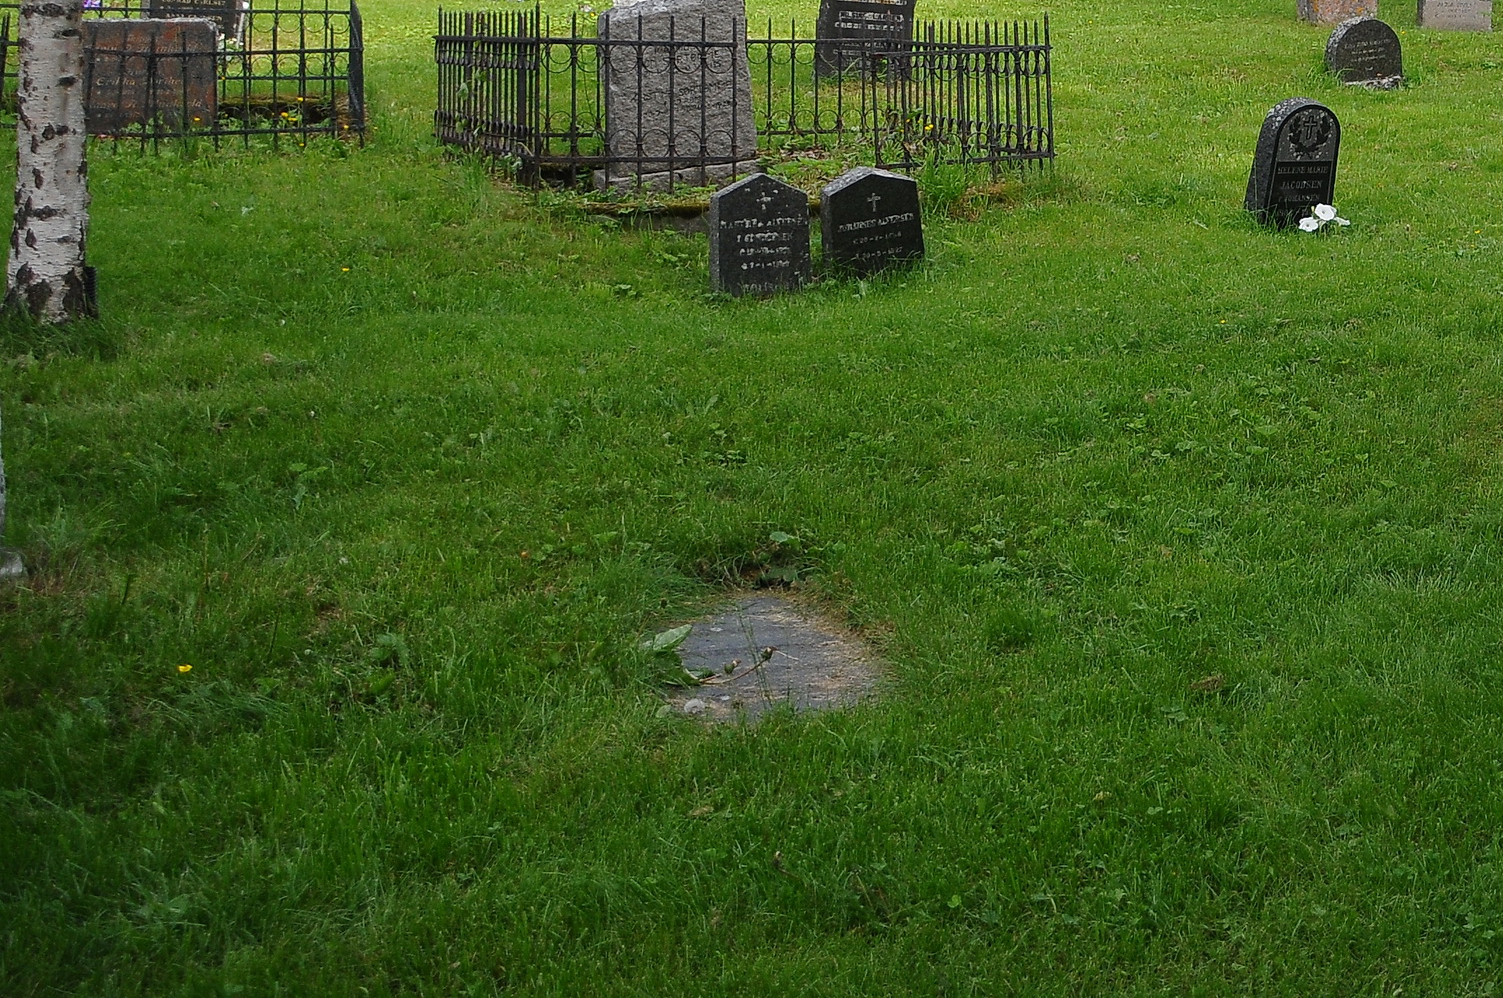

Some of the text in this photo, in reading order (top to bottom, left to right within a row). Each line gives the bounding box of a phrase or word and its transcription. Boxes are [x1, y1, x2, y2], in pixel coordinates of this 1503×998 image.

[1277, 166, 1329, 175] HELENE MARIE
[1280, 180, 1323, 190] JACOBSEN
